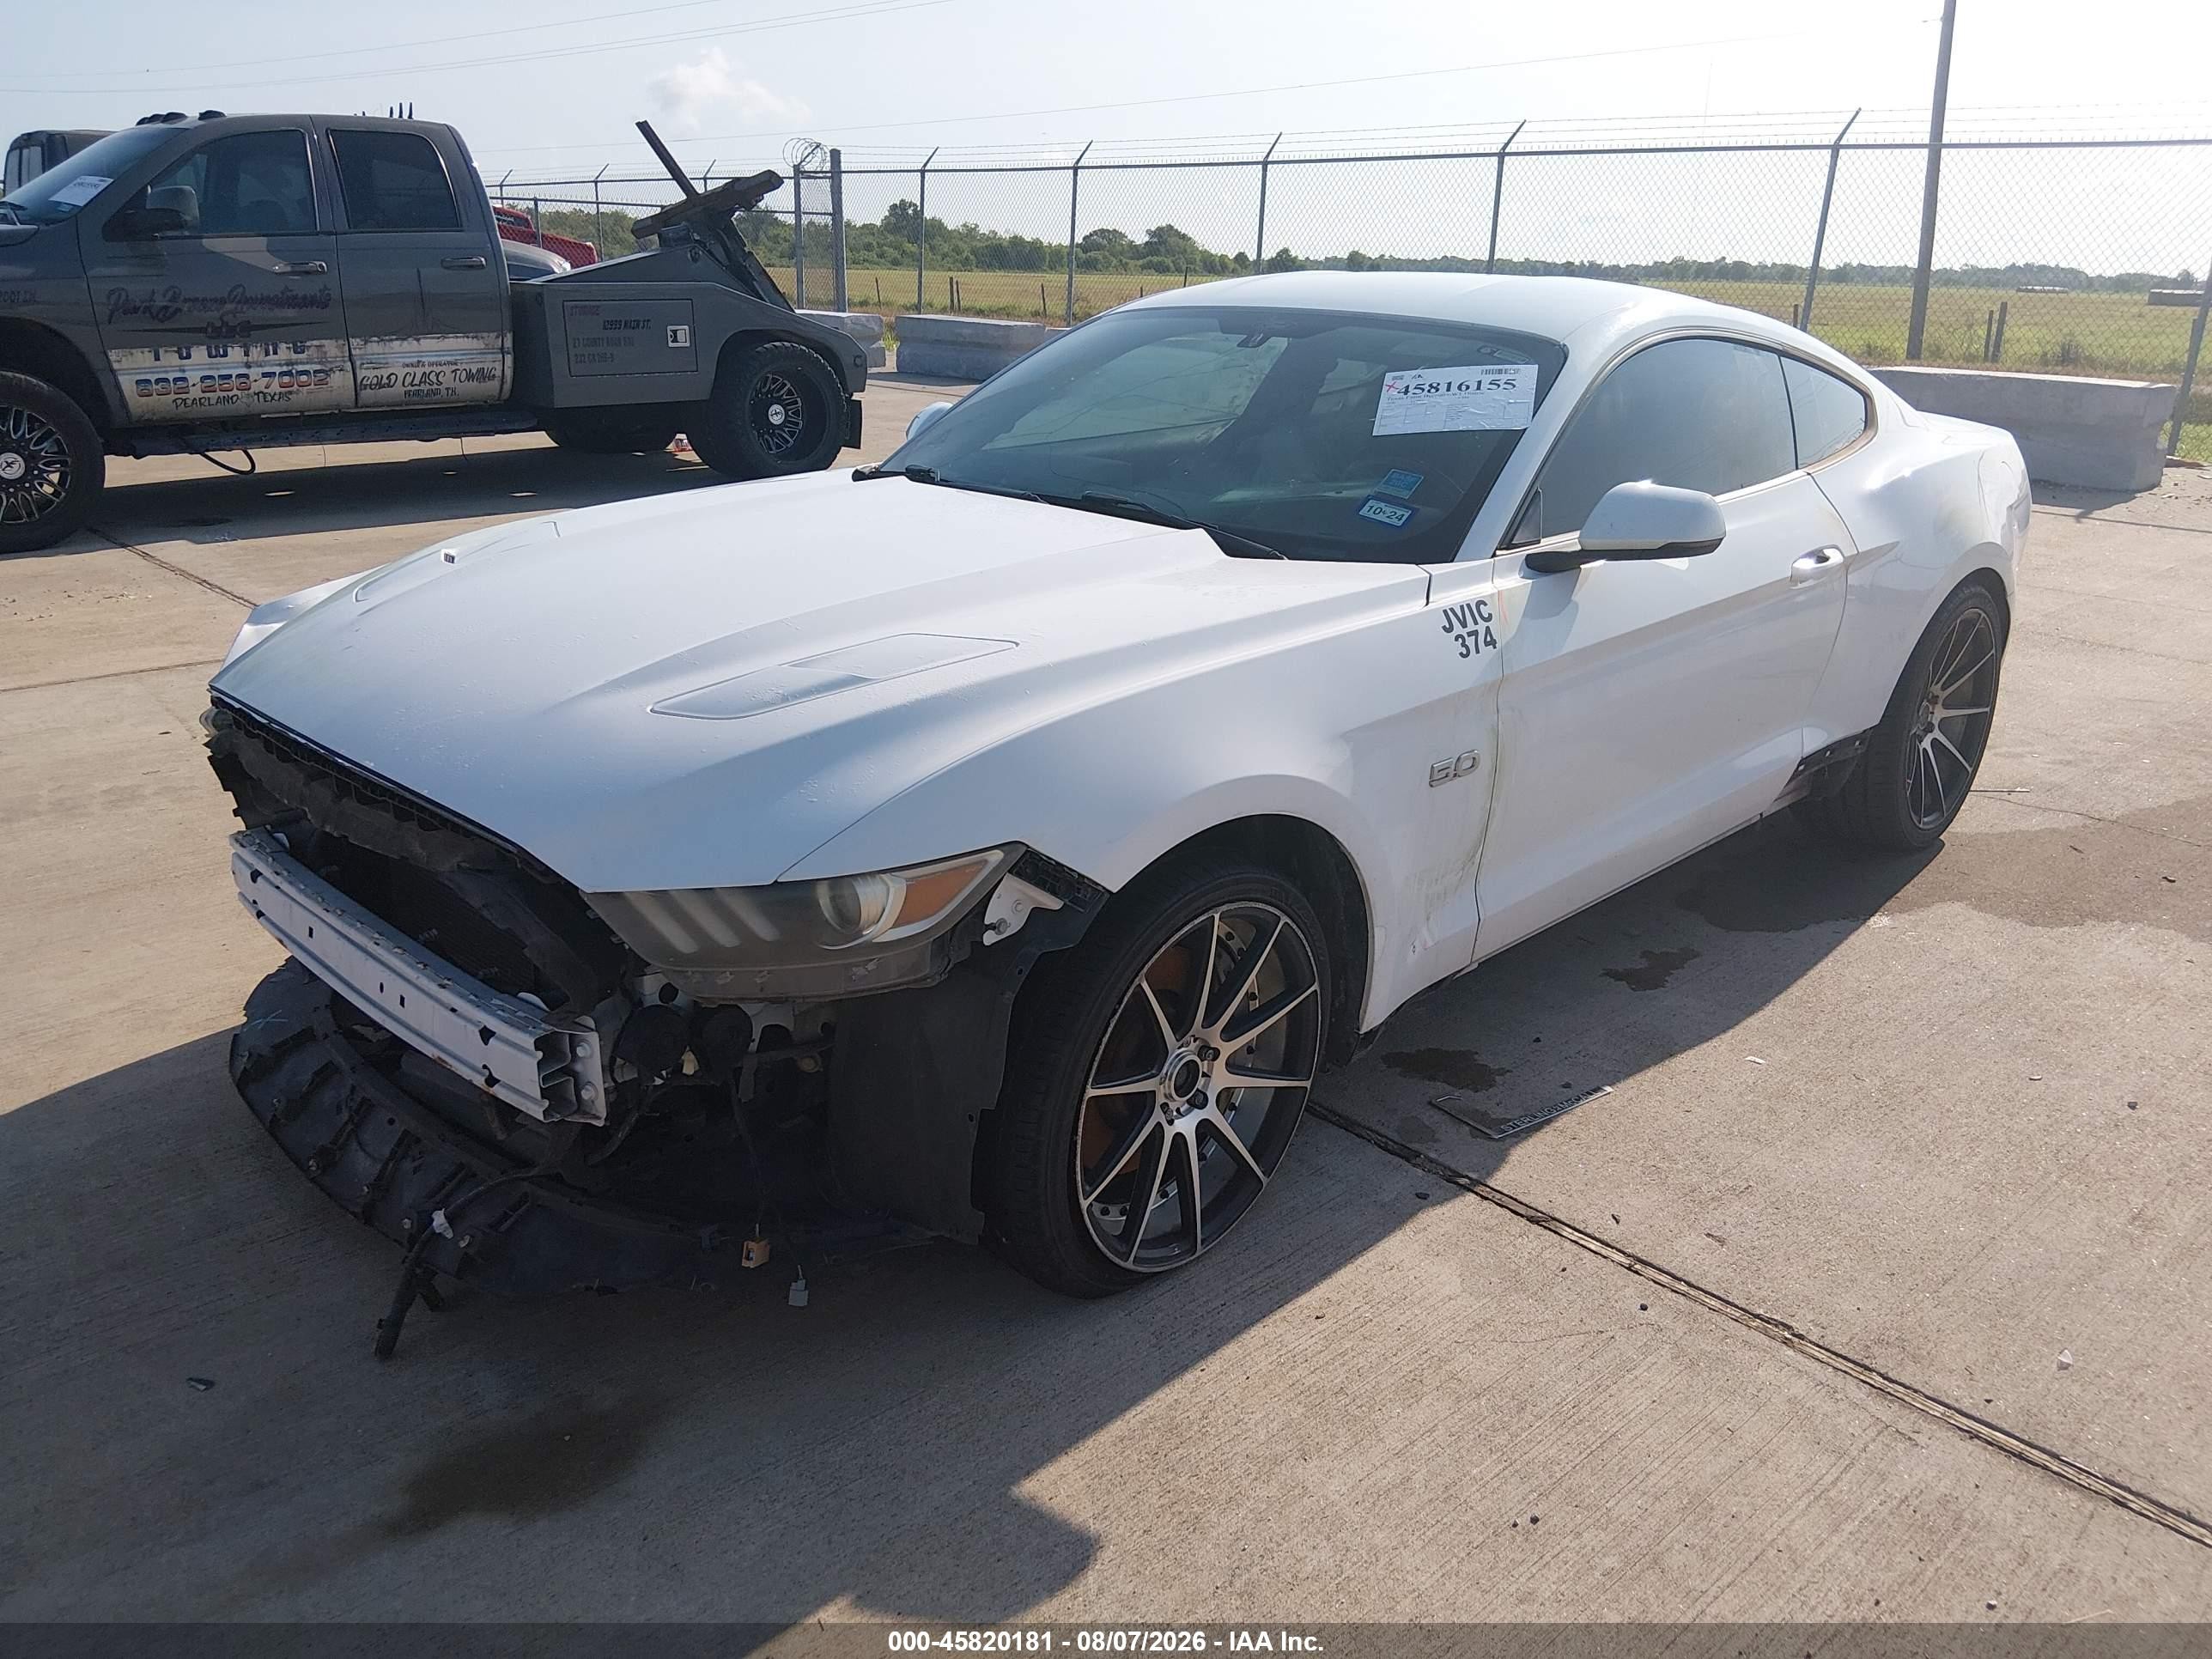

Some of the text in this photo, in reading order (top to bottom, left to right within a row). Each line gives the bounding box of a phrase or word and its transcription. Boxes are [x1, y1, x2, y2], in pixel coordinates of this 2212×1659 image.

[359, 367, 497, 392] GOLD CLASS TOWING
[1397, 378, 1517, 396] 45816155
[173, 390, 292, 410] PEARLAND TEXAS
[1441, 599, 1493, 634] JVIC
[1454, 625, 1498, 659] 374
[1429, 749, 1480, 787] 5.0
